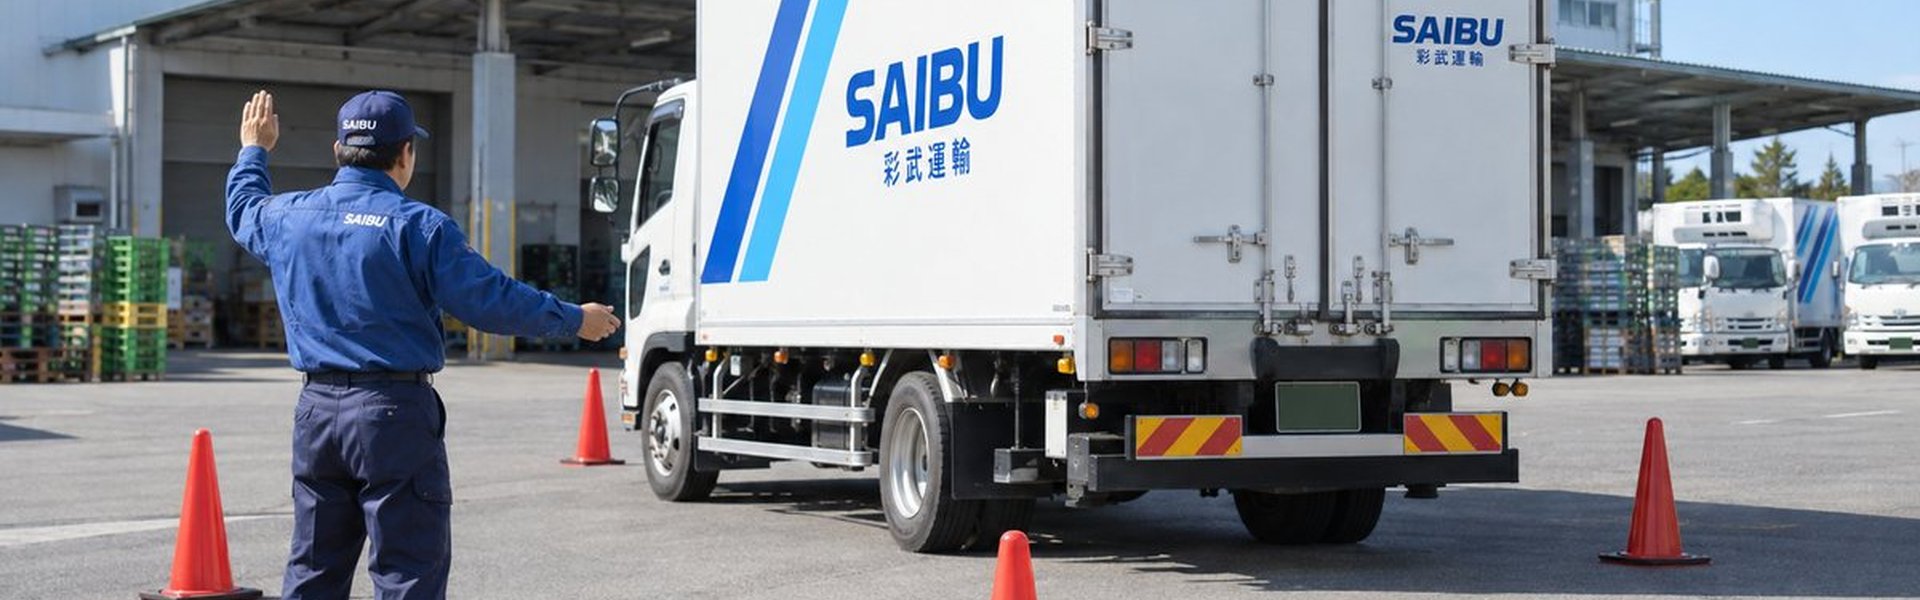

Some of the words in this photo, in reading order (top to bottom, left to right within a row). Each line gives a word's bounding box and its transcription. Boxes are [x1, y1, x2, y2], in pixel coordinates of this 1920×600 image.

[1392, 14, 1504, 47] SAIBU
[1416, 48, 1484, 67] 彩武運輸
[846, 35, 1004, 148] SAIBU
[342, 119, 377, 130] SAIBU
[884, 136, 971, 187] 彩武運輸
[343, 213, 387, 228] SAIBU
